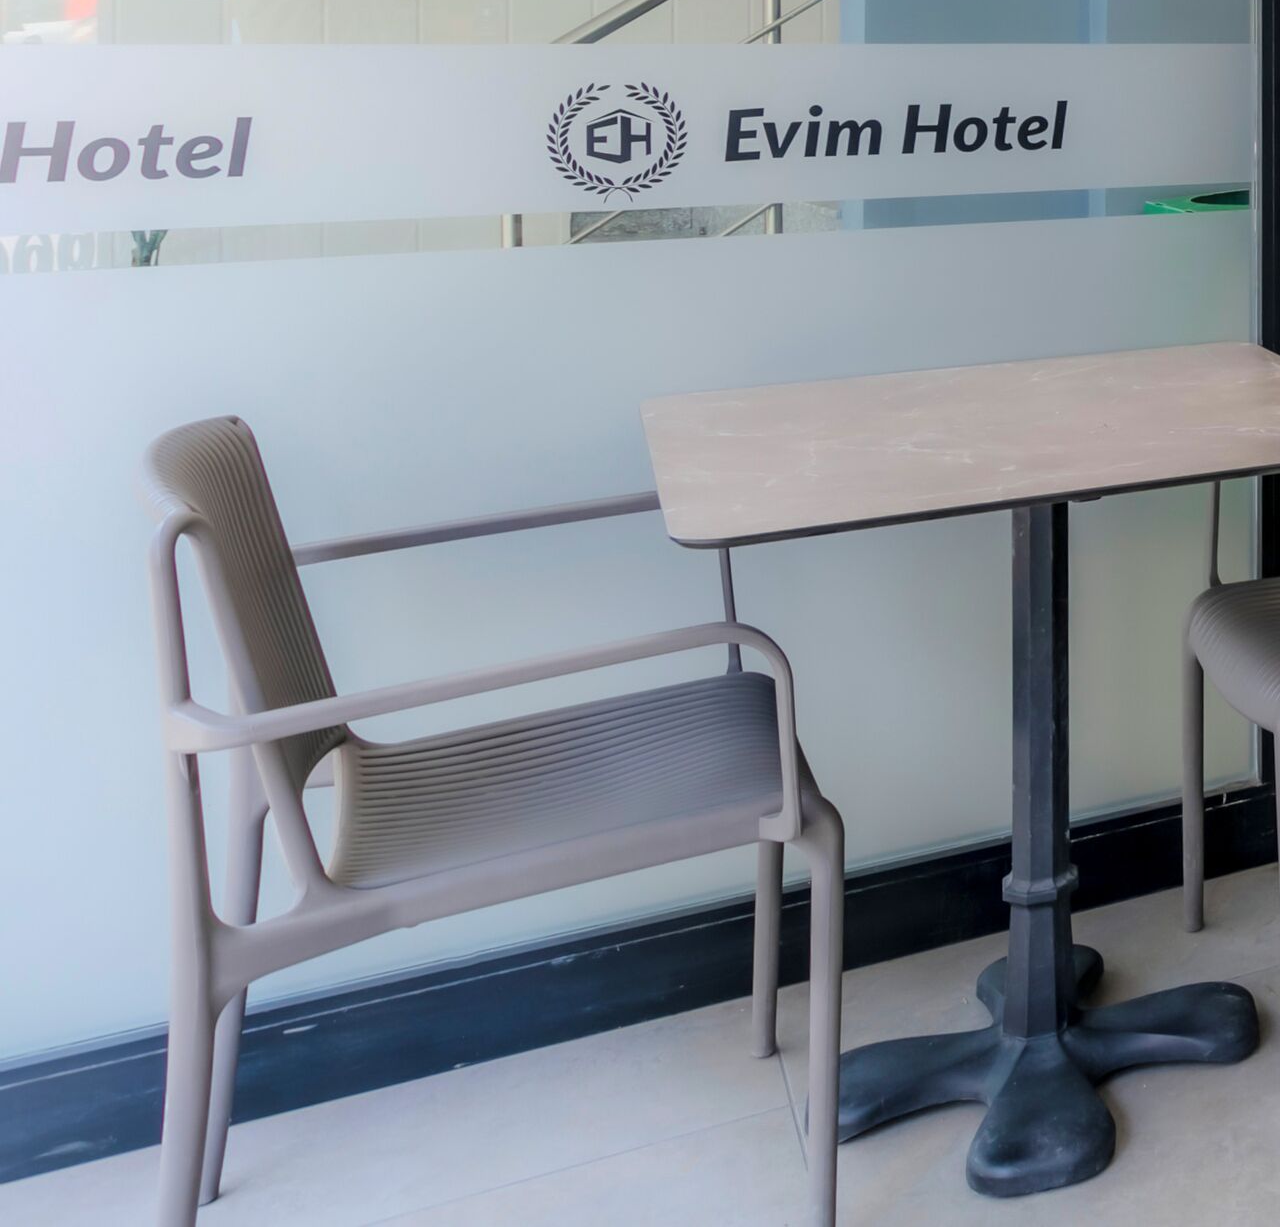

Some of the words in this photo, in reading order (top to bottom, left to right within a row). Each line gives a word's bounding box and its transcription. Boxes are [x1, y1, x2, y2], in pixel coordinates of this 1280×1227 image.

[0, 116, 253, 184] Hotel
[724, 104, 883, 162] Evim
[901, 100, 1068, 155] Hotel
